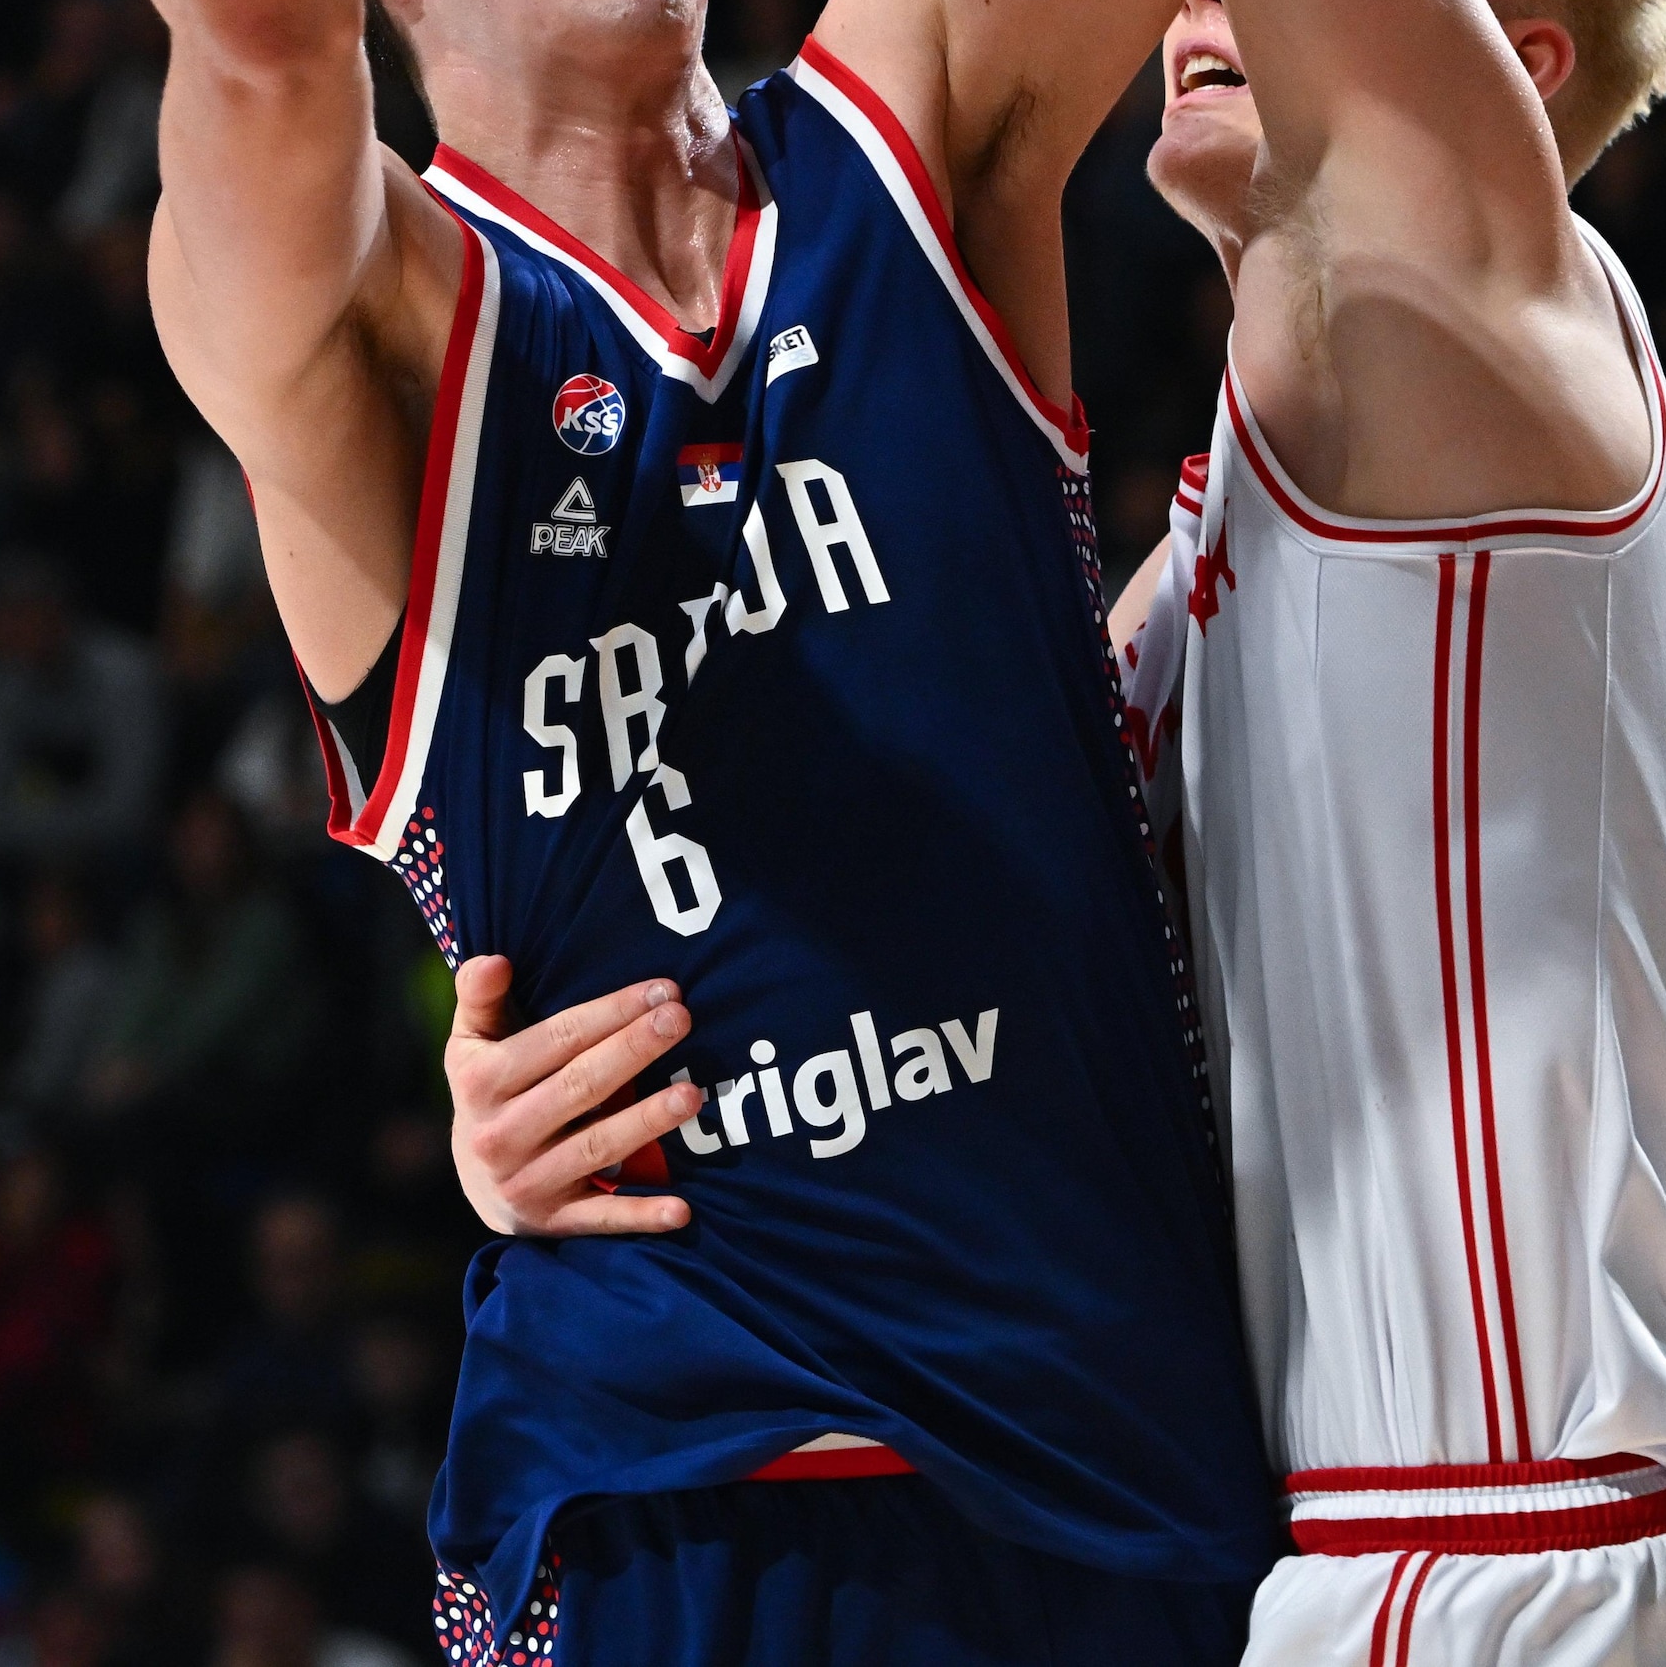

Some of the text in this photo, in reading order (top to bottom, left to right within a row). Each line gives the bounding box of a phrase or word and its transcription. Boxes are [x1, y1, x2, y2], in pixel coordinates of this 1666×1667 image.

[562, 406, 619, 436] KSS
[530, 522, 612, 558] PEAK
[522, 458, 892, 819] SRJA
[625, 762, 723, 937] 6
[669, 1007, 999, 1159] triglav
